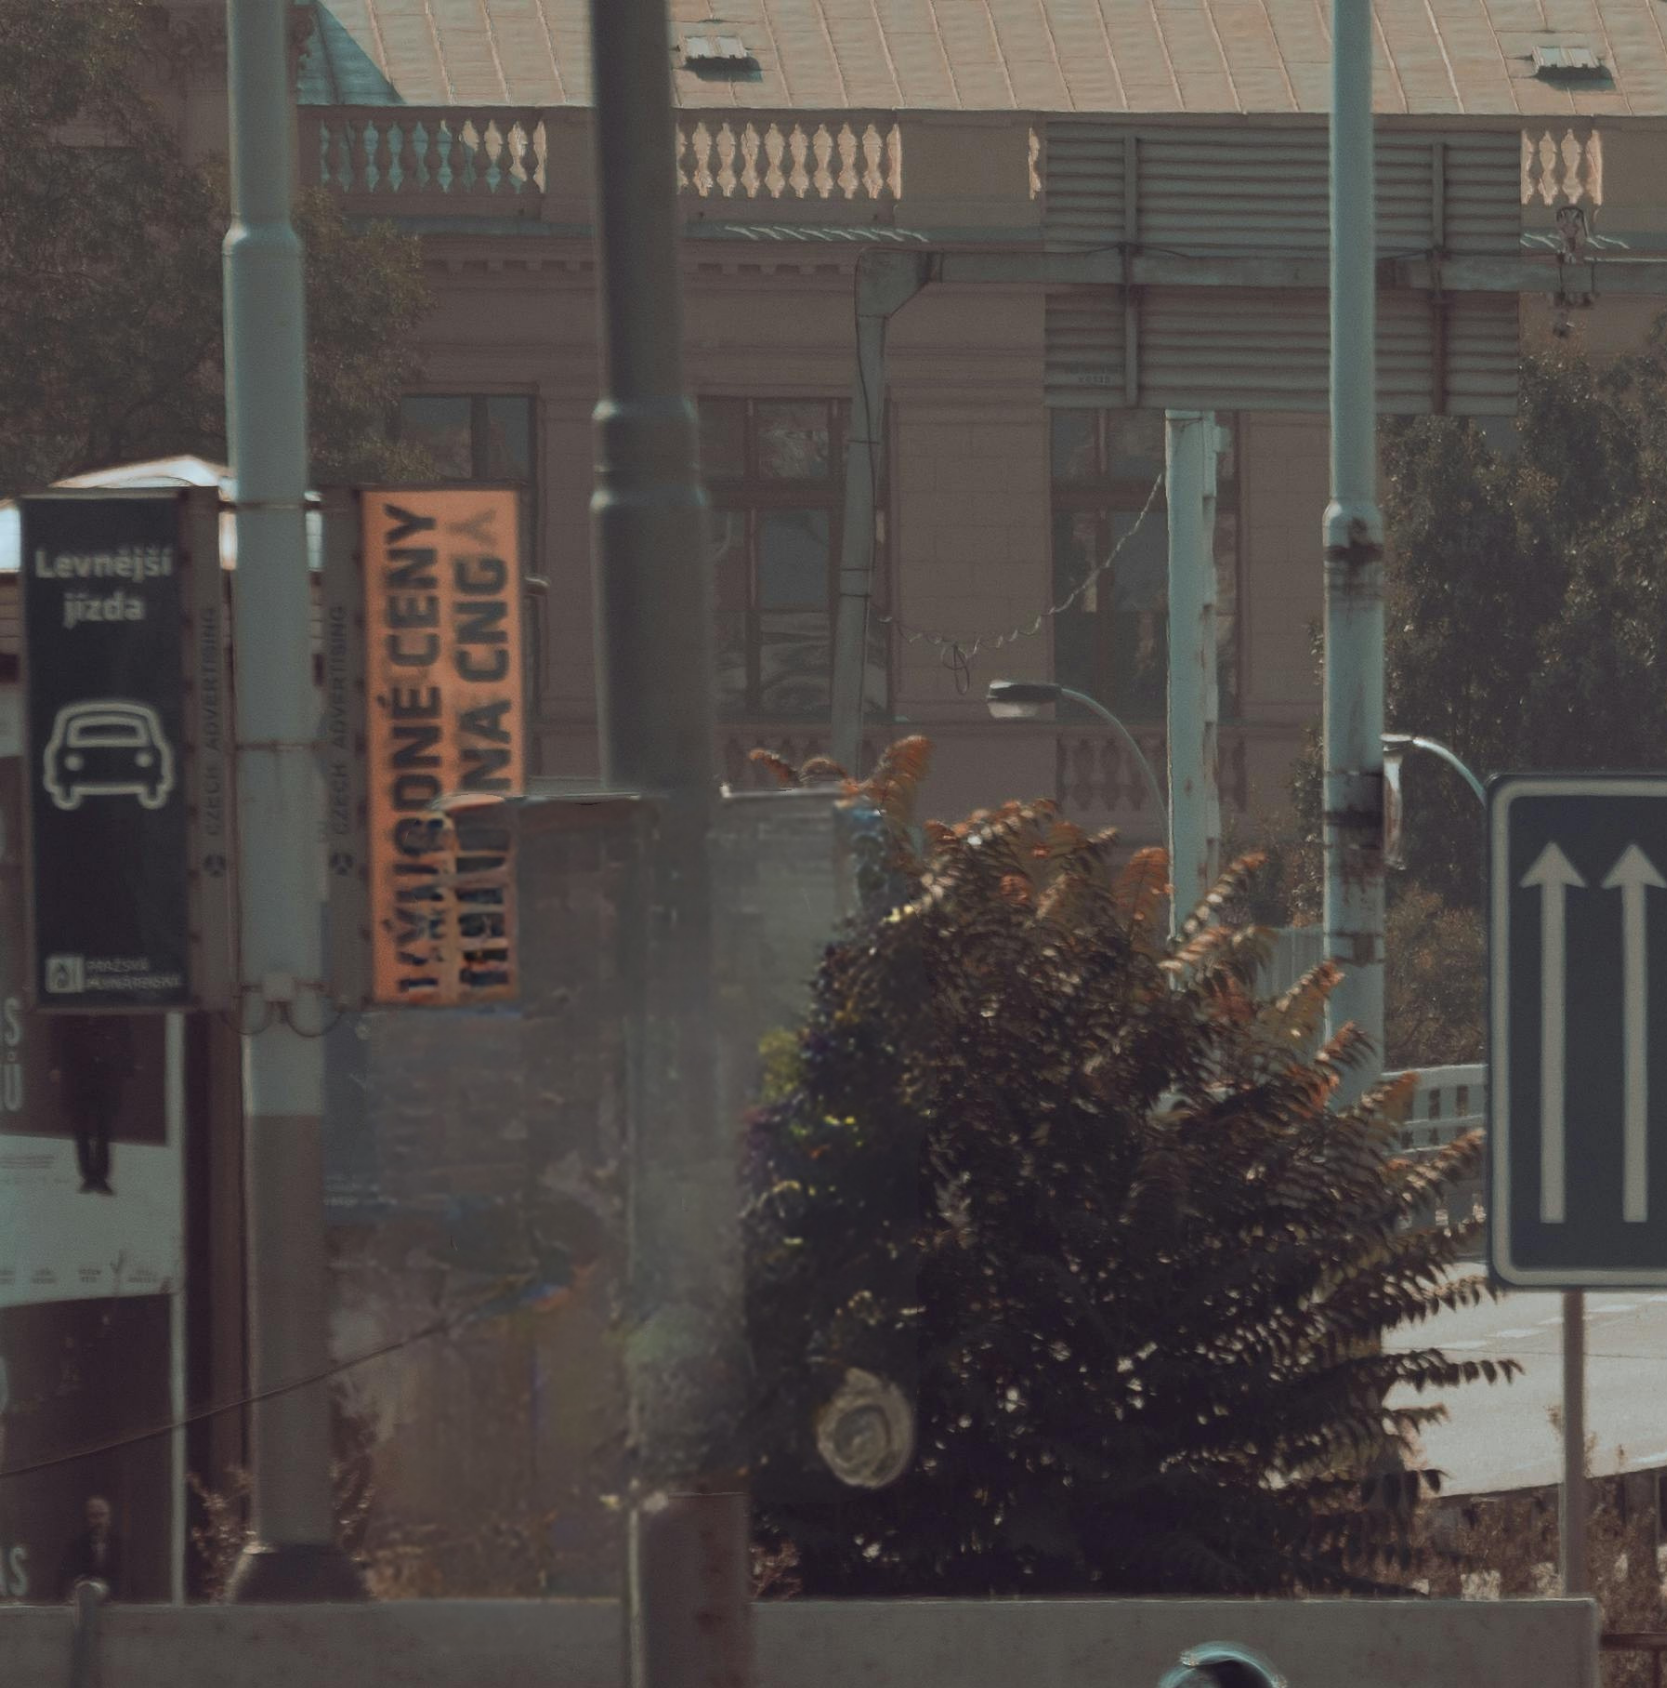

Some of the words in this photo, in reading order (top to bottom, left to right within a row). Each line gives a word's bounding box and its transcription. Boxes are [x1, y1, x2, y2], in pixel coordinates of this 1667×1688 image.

[36, 547, 173, 583] Levnější
[63, 591, 146, 629] jízda
[383, 503, 440, 668] CENY
[455, 556, 511, 684] CNG
[329, 606, 348, 750] ADVERTISING
[459, 700, 512, 791] NA
[331, 765, 349, 836] CZECH
